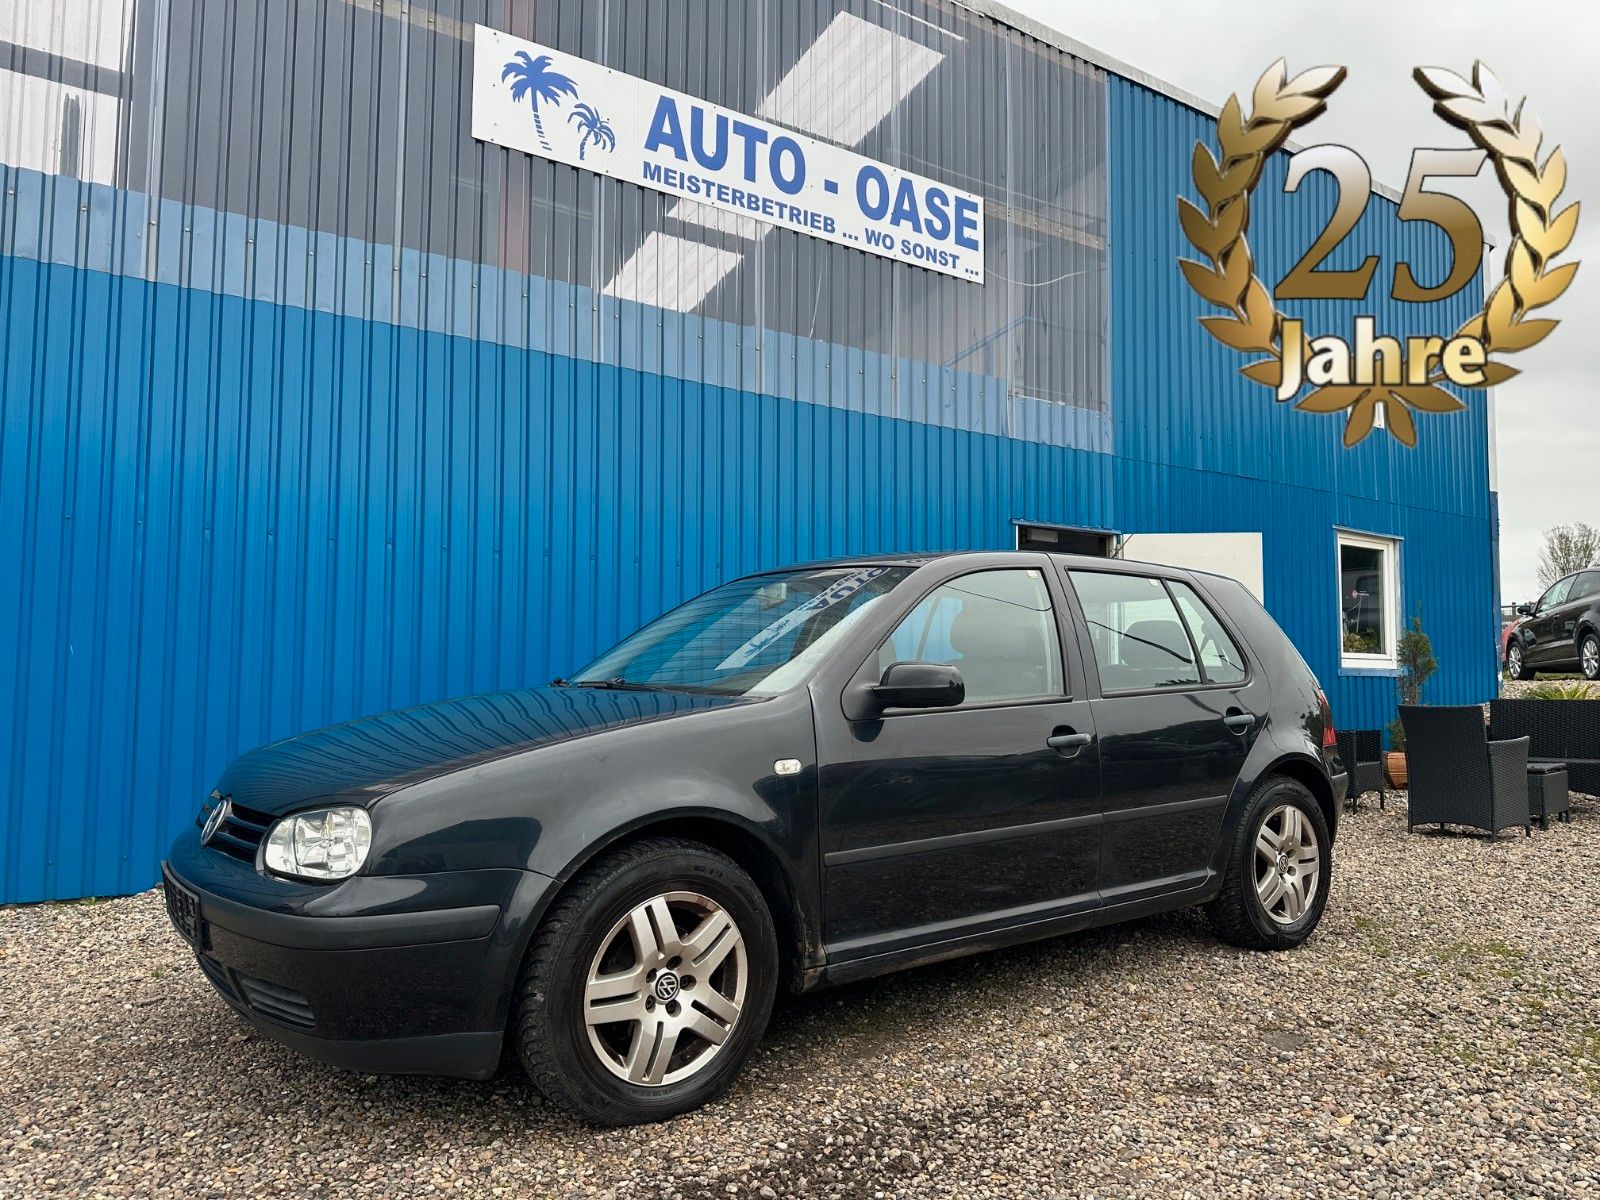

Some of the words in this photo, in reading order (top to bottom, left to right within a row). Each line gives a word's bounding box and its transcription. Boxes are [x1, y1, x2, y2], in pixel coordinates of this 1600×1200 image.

[643, 160, 836, 234] MEISTERBETRIEB
[865, 227, 895, 251] WO
[900, 241, 960, 270] SONST
[644, 95, 806, 195] AUTO
[856, 165, 979, 251] OASE
